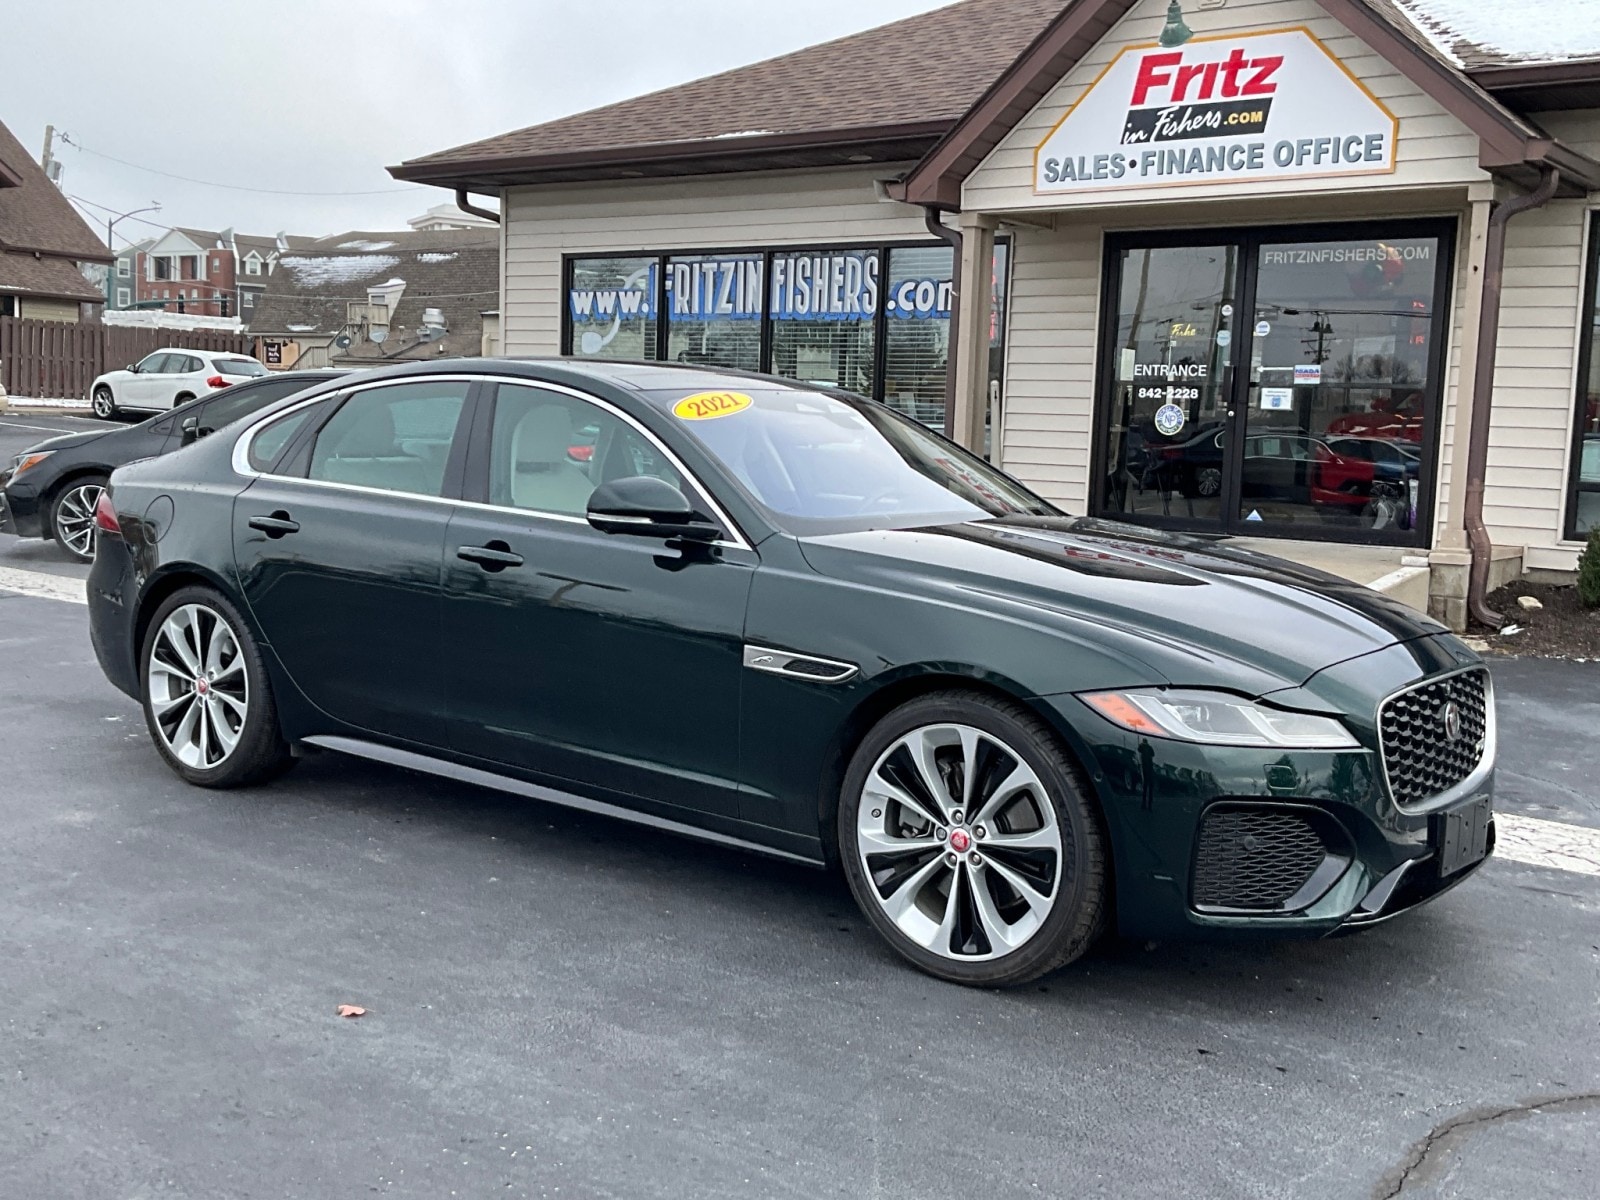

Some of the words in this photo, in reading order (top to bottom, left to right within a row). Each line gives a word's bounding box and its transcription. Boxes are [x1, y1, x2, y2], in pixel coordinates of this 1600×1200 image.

[1130, 48, 1284, 106] Fritz
[1124, 123, 1148, 144] in
[1272, 133, 1384, 168] OFFICE
[1134, 364, 1207, 377] ENTRANCE
[1138, 387, 1199, 399] 842-2228
[687, 393, 742, 417] 2021
